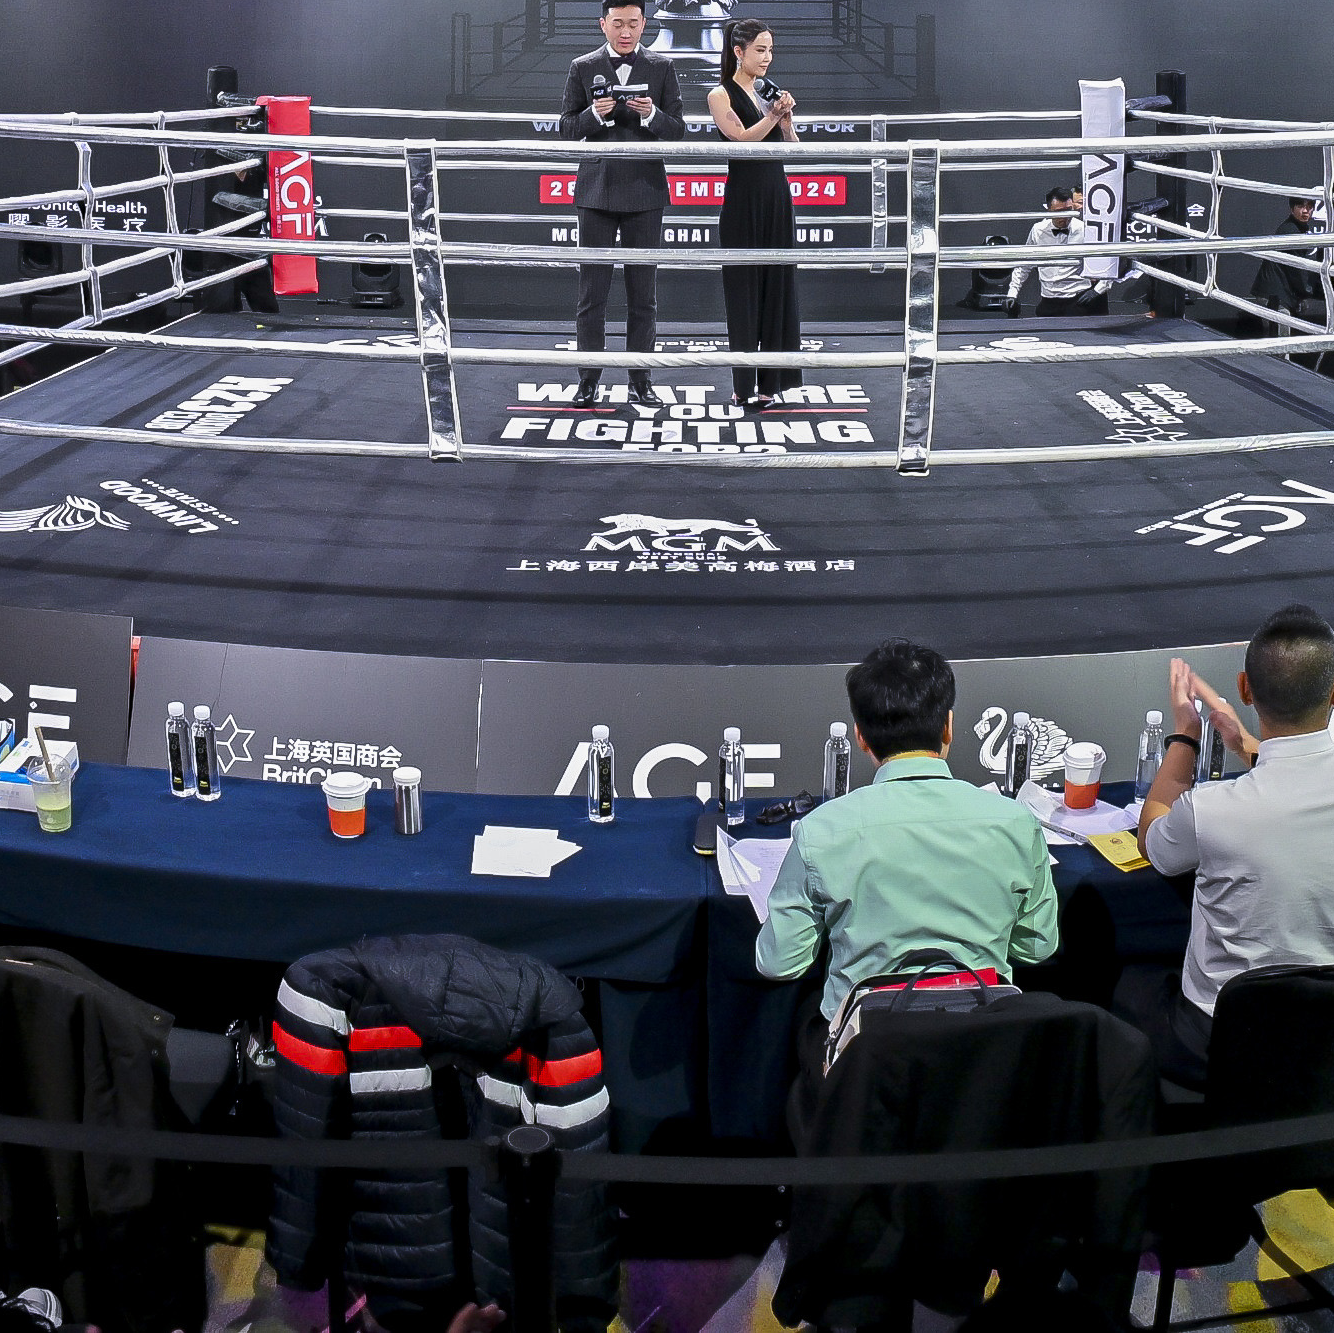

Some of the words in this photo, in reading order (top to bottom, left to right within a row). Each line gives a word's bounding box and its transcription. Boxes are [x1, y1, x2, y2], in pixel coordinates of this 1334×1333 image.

[789, 181, 836, 197] 024
[95, 200, 147, 214] Health
[796, 228, 834, 243] UND
[773, 384, 871, 404] RE
[630, 403, 745, 420] YOU
[499, 417, 875, 444] FIGHTING
[99, 480, 220, 534] LINWOOD
[579, 534, 781, 552] MGM
[263, 736, 403, 768] 上海英国商会
[262, 763, 382, 789] BritC
